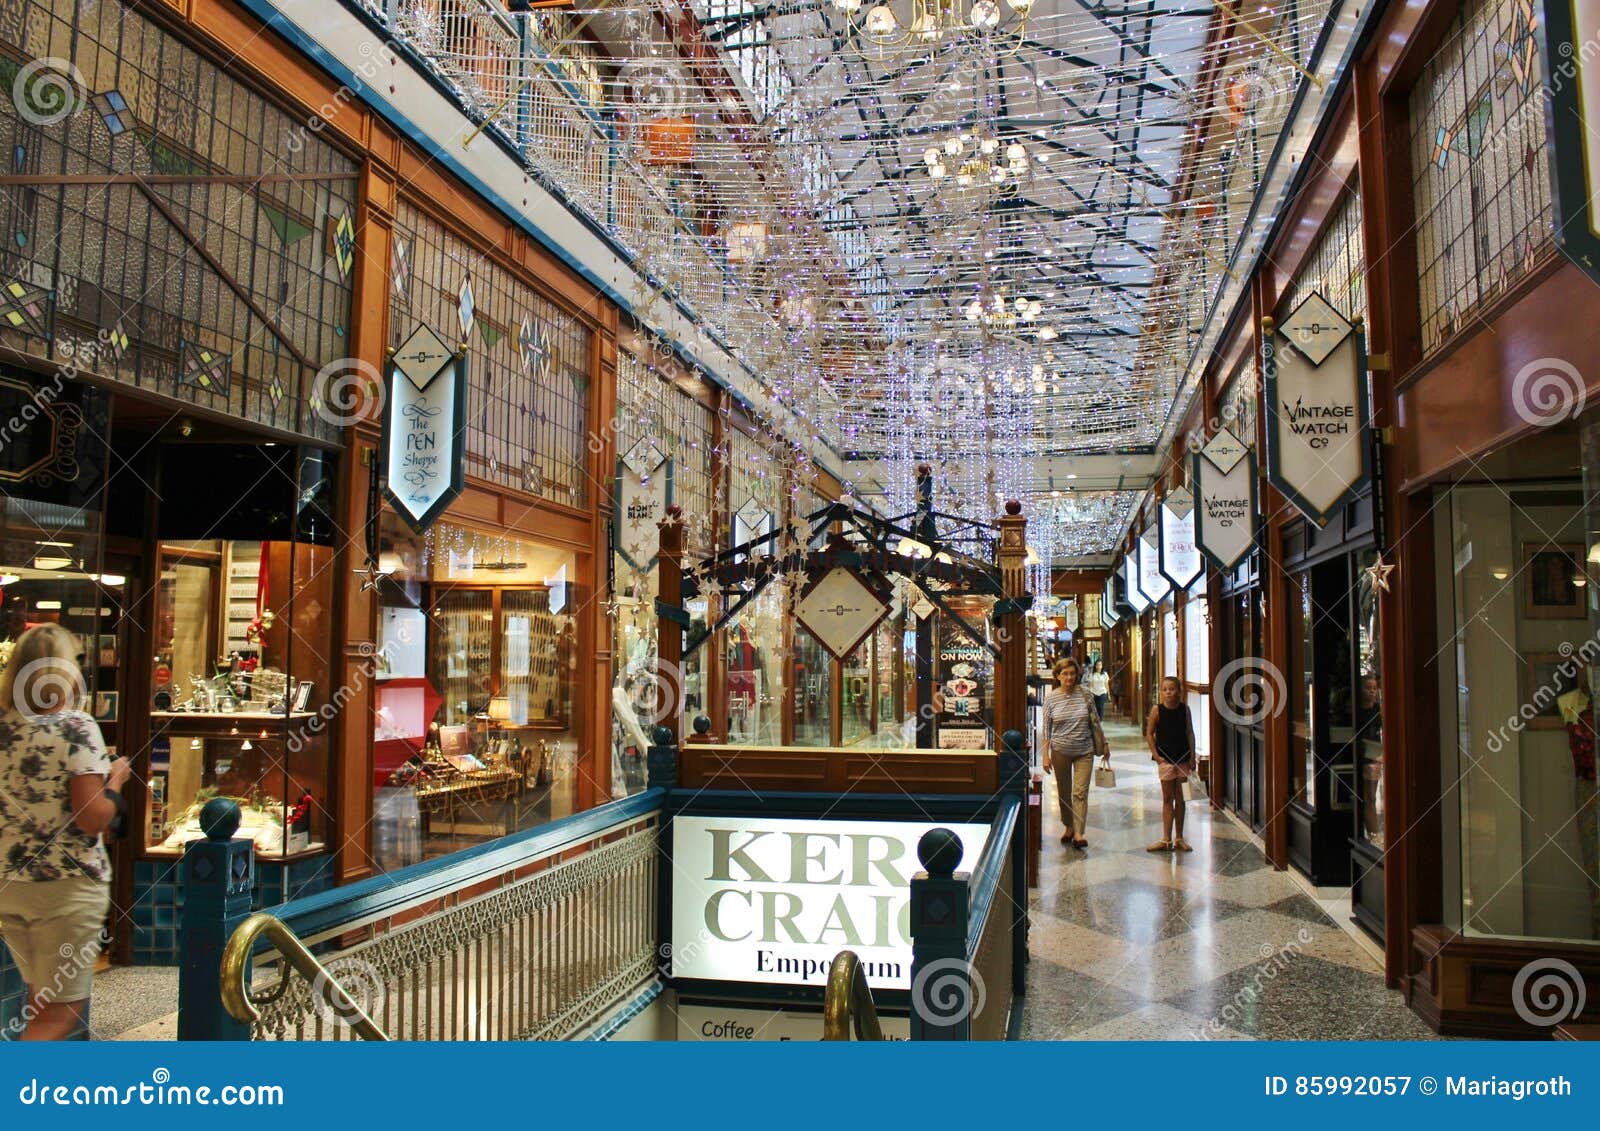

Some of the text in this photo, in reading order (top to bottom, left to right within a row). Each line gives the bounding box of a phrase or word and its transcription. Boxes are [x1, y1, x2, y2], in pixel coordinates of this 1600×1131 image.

[1281, 395, 1354, 422] VINTAGE
[408, 416, 429, 430] The
[1290, 423, 1348, 434] WATCH
[406, 432, 435, 450] PEN
[1204, 494, 1248, 510] VINTAGE
[940, 653, 982, 661] ON NOW
[704, 828, 912, 888] KER
[757, 950, 901, 980] Empoum
[701, 1020, 754, 1040] Coffee
